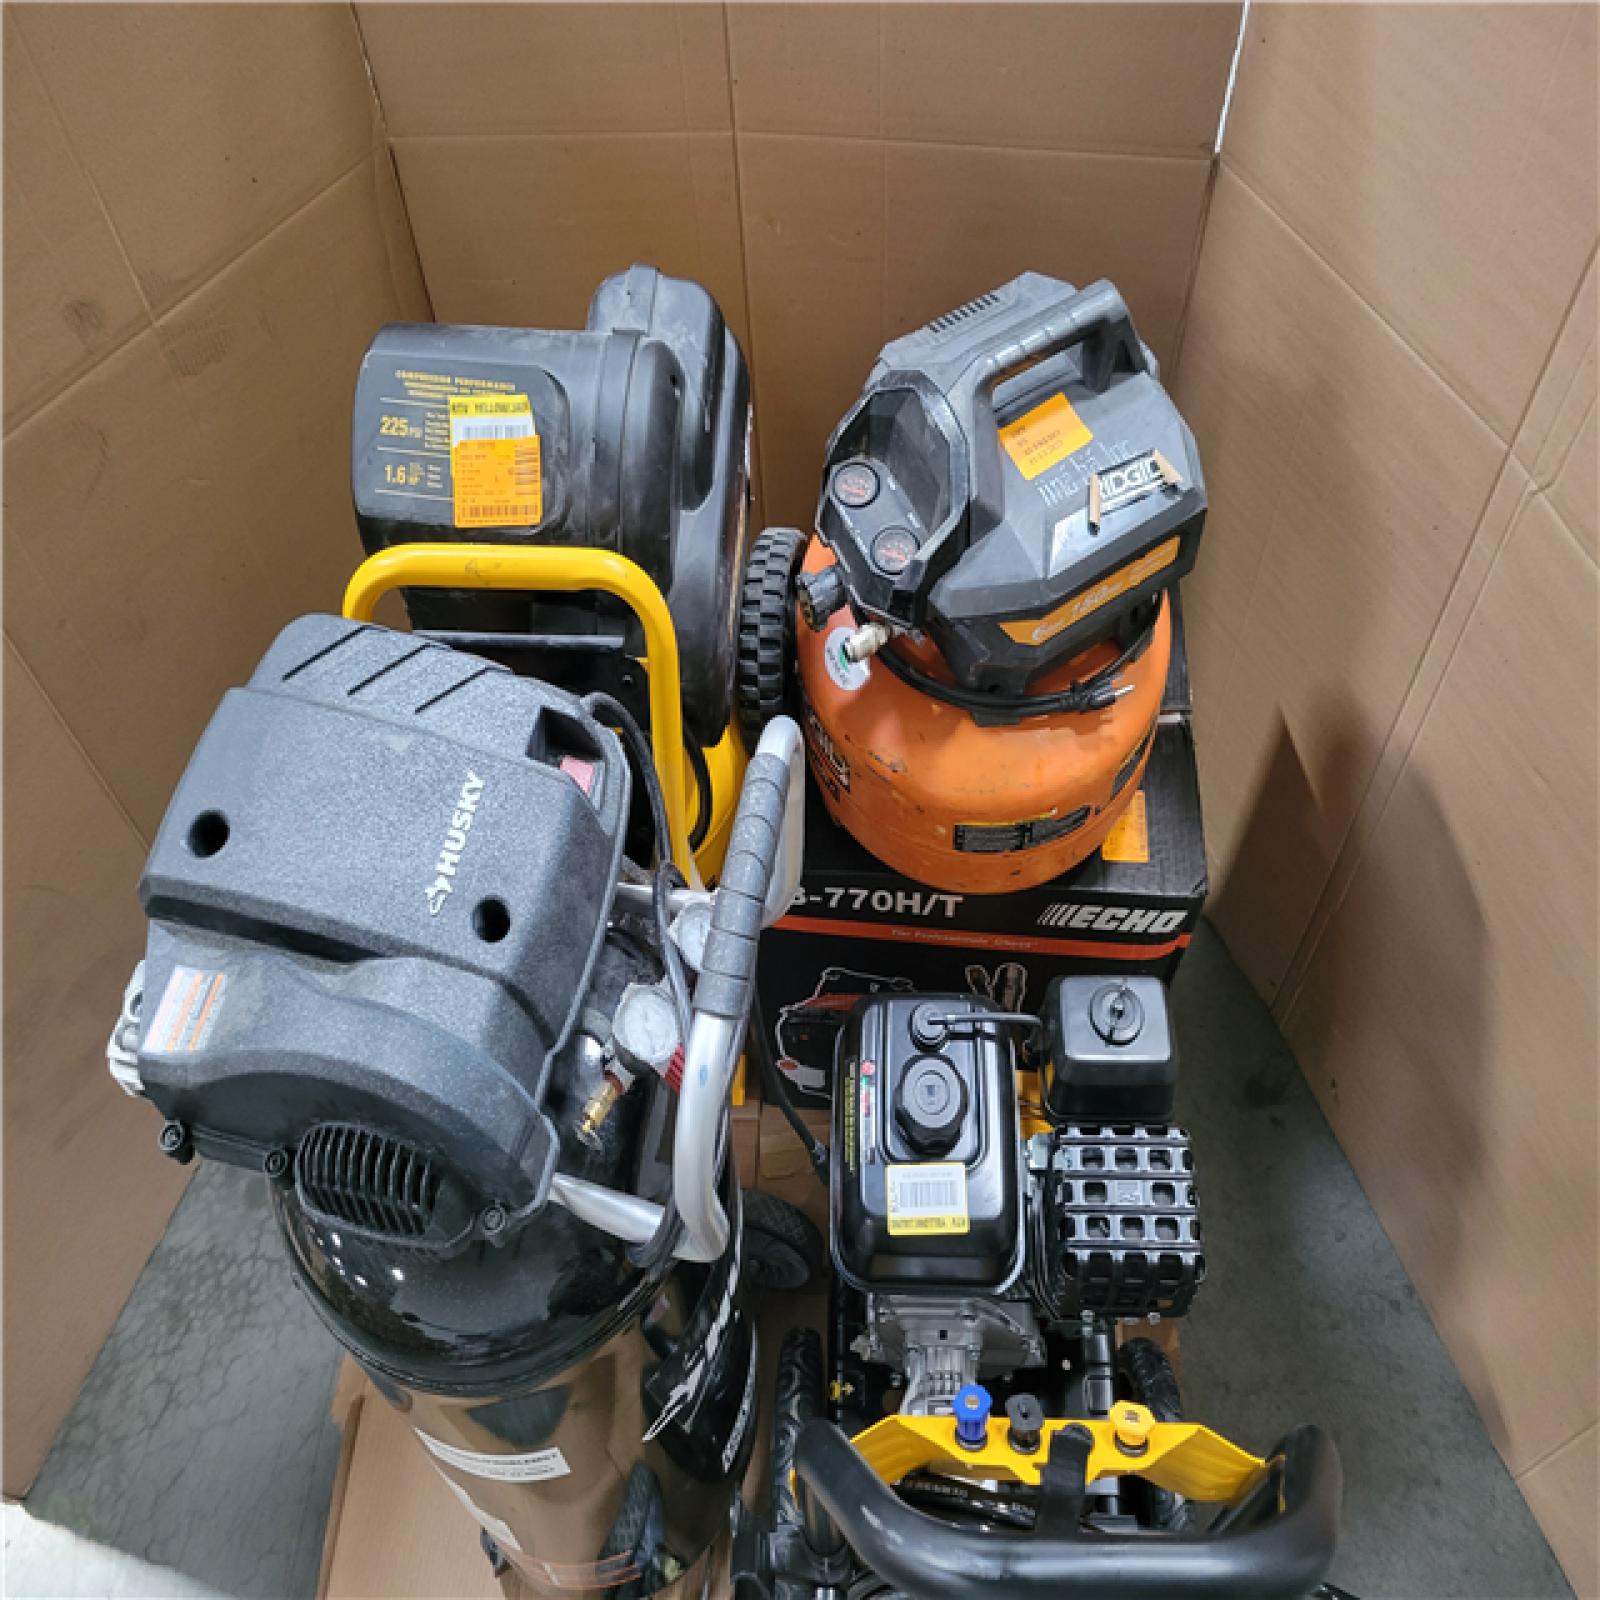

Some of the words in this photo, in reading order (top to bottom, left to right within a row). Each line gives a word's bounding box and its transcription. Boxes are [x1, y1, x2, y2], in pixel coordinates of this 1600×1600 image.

[380, 415, 408, 436] 225
[384, 463, 406, 485] 1.6
[436, 769, 484, 875] HUSKY
[1068, 905, 1187, 933] ECHO
